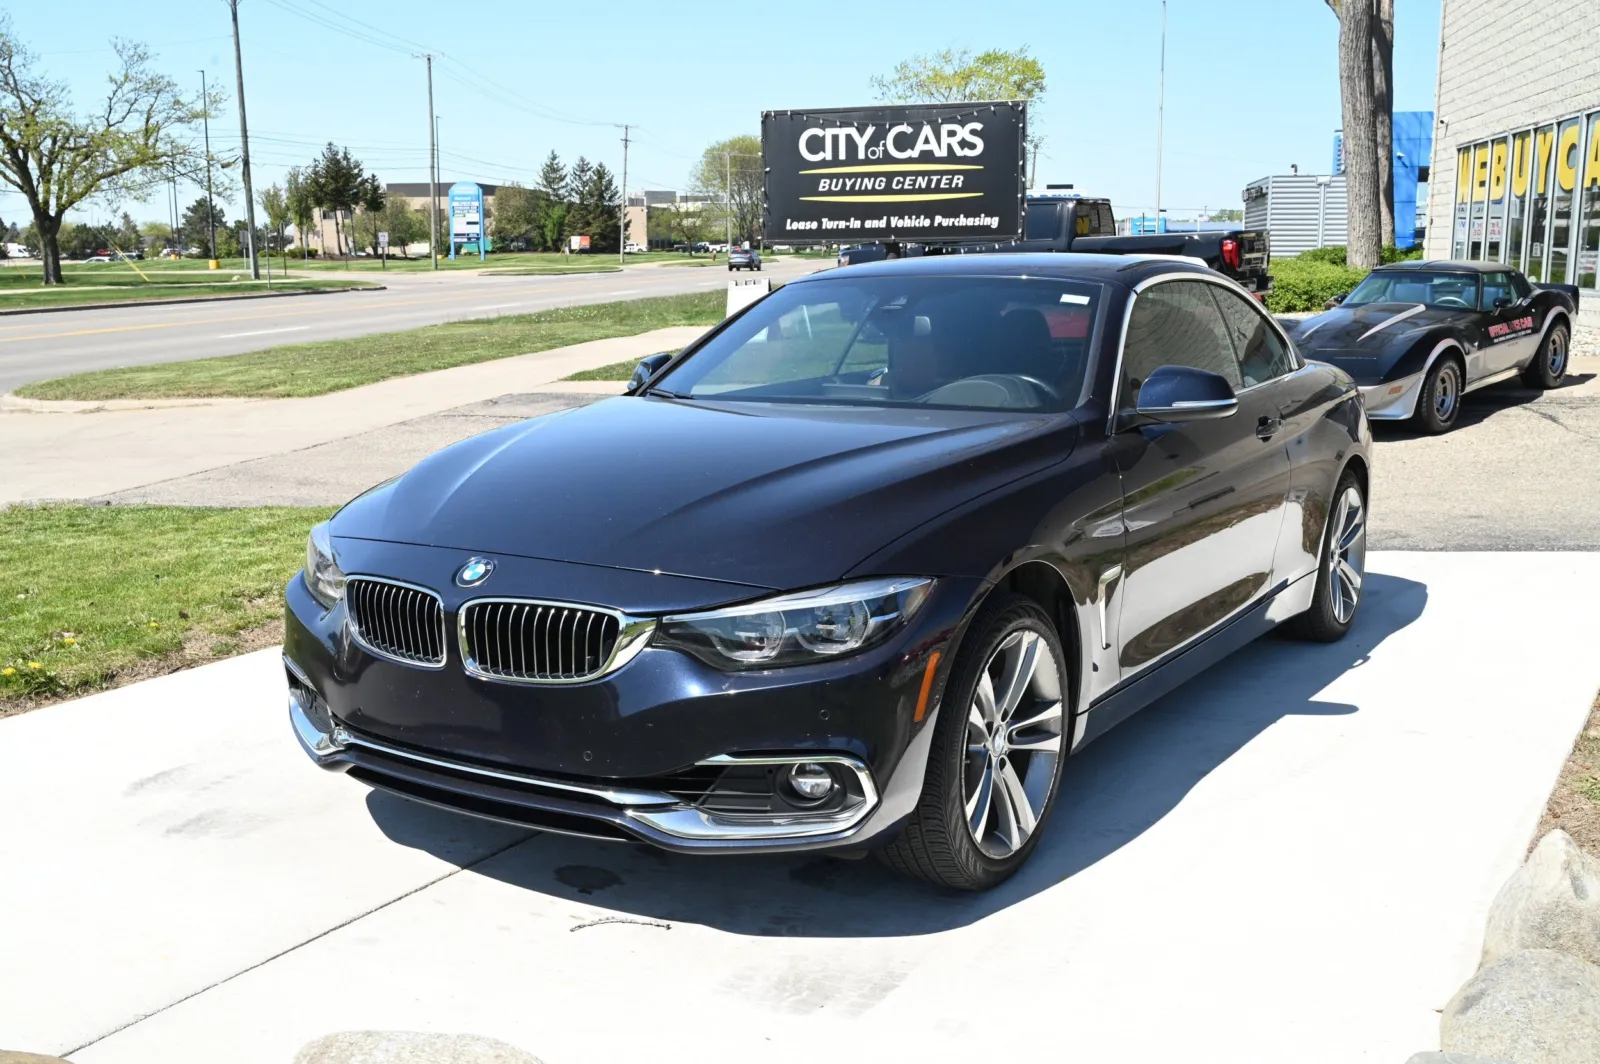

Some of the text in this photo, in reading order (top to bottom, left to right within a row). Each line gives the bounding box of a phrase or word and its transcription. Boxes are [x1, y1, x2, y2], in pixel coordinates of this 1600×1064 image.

[799, 122, 984, 162] CITY of CARS
[1457, 146, 1489, 203] WE
[1490, 131, 1553, 200] BUY
[818, 175, 964, 192] BUYING CENTER
[786, 213, 999, 230] Lease Turn-In and Vehicle Purchasing
